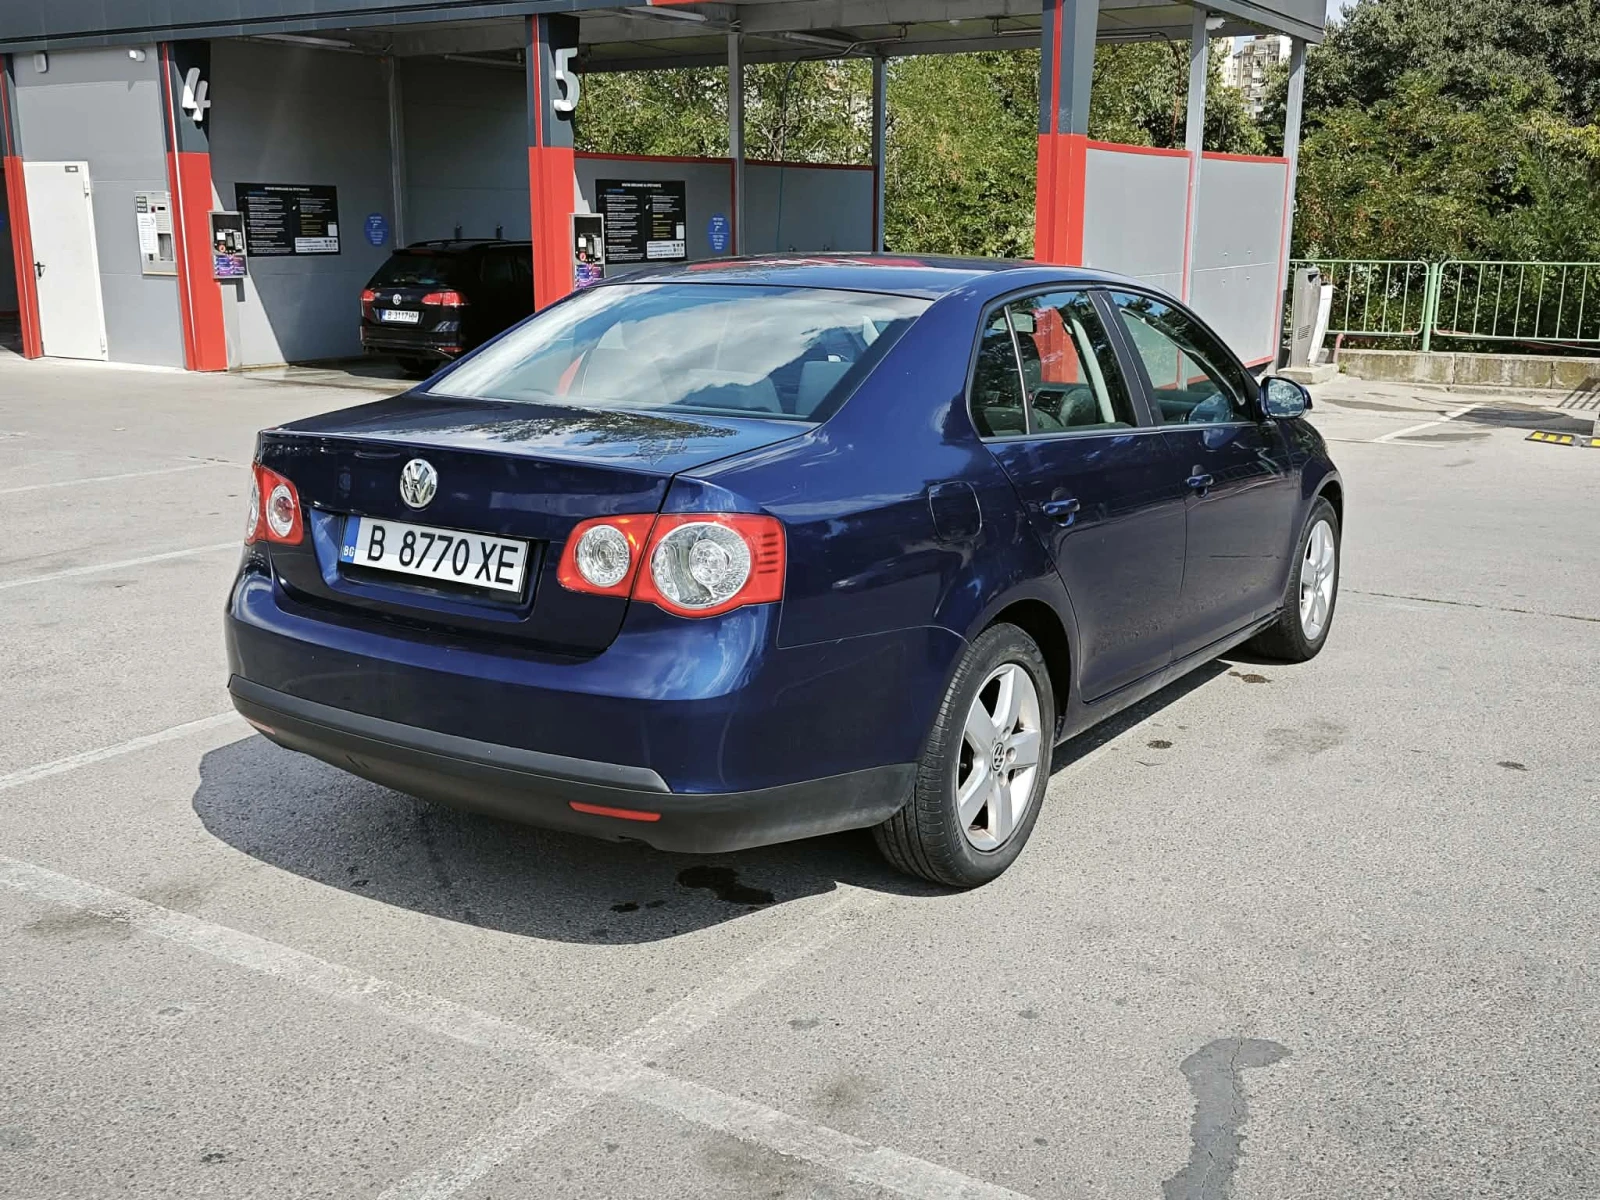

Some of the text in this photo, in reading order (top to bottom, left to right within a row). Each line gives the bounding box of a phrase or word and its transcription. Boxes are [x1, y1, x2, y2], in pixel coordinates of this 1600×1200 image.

[182, 67, 212, 122] 4
[554, 47, 580, 112] 5
[343, 545, 355, 557] BG
[367, 525, 519, 585] B 8770 XE
